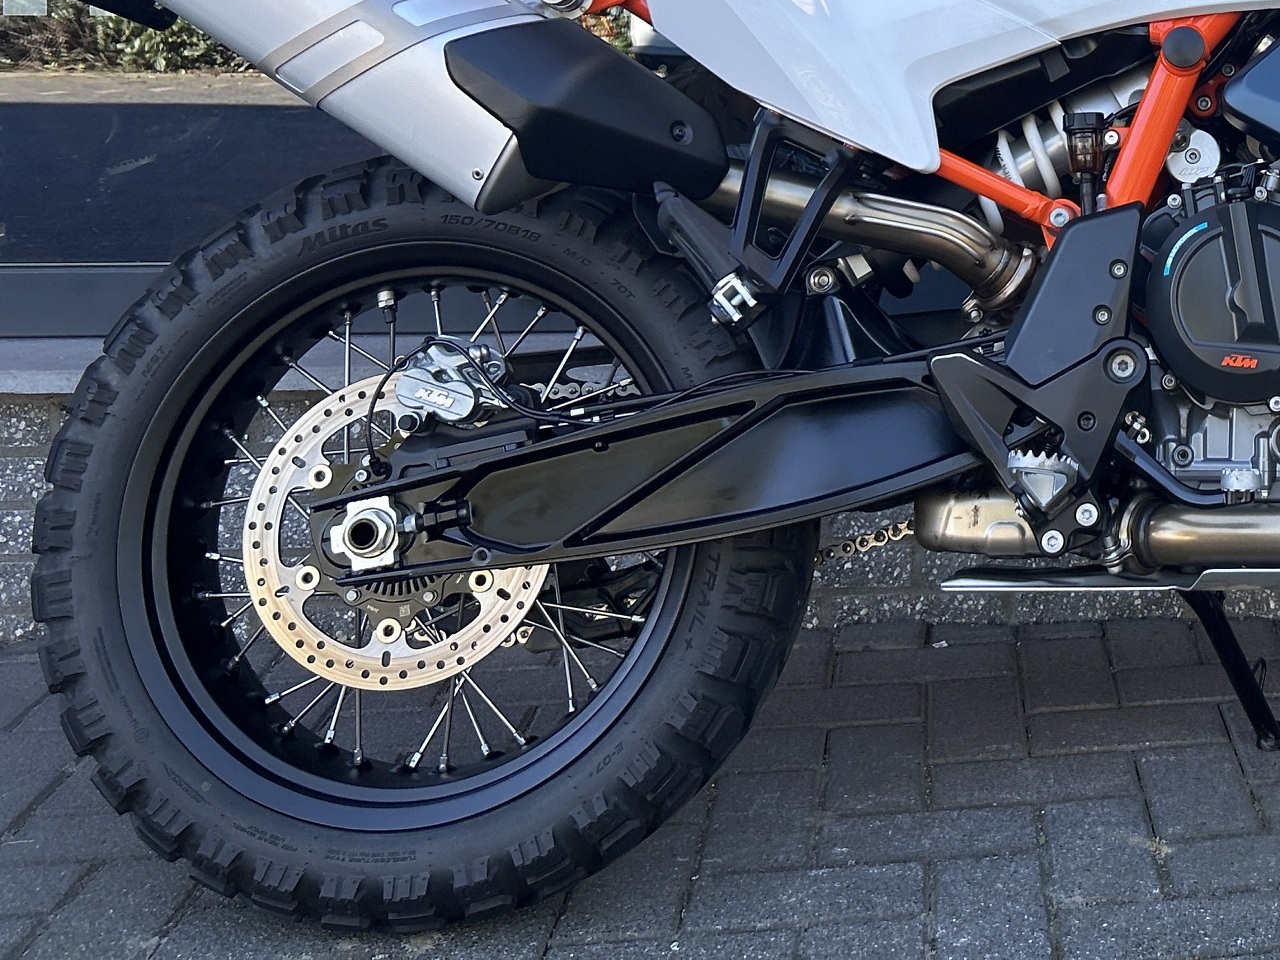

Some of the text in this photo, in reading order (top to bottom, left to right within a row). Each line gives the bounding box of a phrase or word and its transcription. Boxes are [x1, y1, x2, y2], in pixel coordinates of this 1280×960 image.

[293, 216, 389, 258] Mitas
[439, 212, 542, 244] 150/70B18
[609, 277, 636, 302] 70T
[1221, 353, 1259, 369] KTM
[414, 385, 456, 409] KTM
